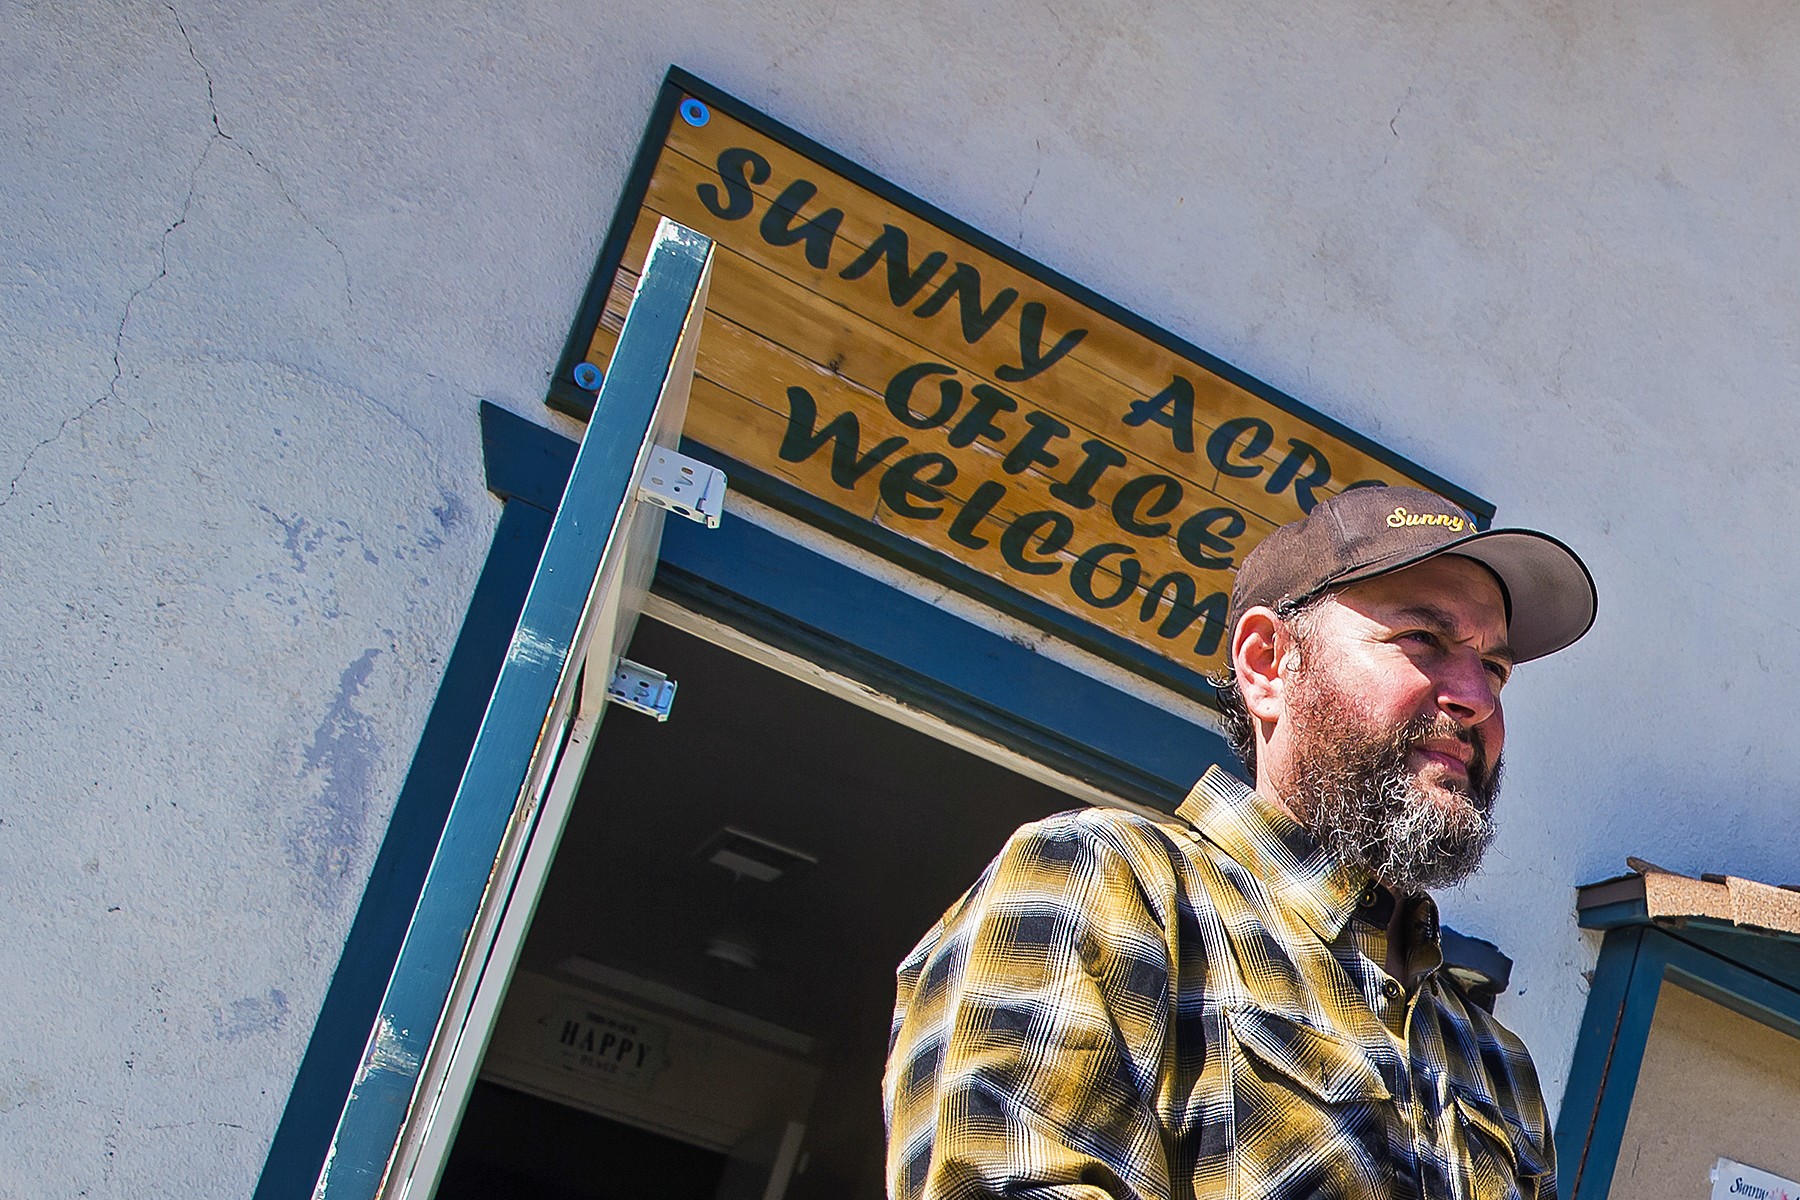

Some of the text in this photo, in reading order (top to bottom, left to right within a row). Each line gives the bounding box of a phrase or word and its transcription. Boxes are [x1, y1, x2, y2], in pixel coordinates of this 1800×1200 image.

[695, 146, 1390, 517] SUNNY ACR
[777, 385, 1231, 656] WELCOM
[1385, 506, 1465, 533] Sunny
[559, 1019, 650, 1068] HAPPY
